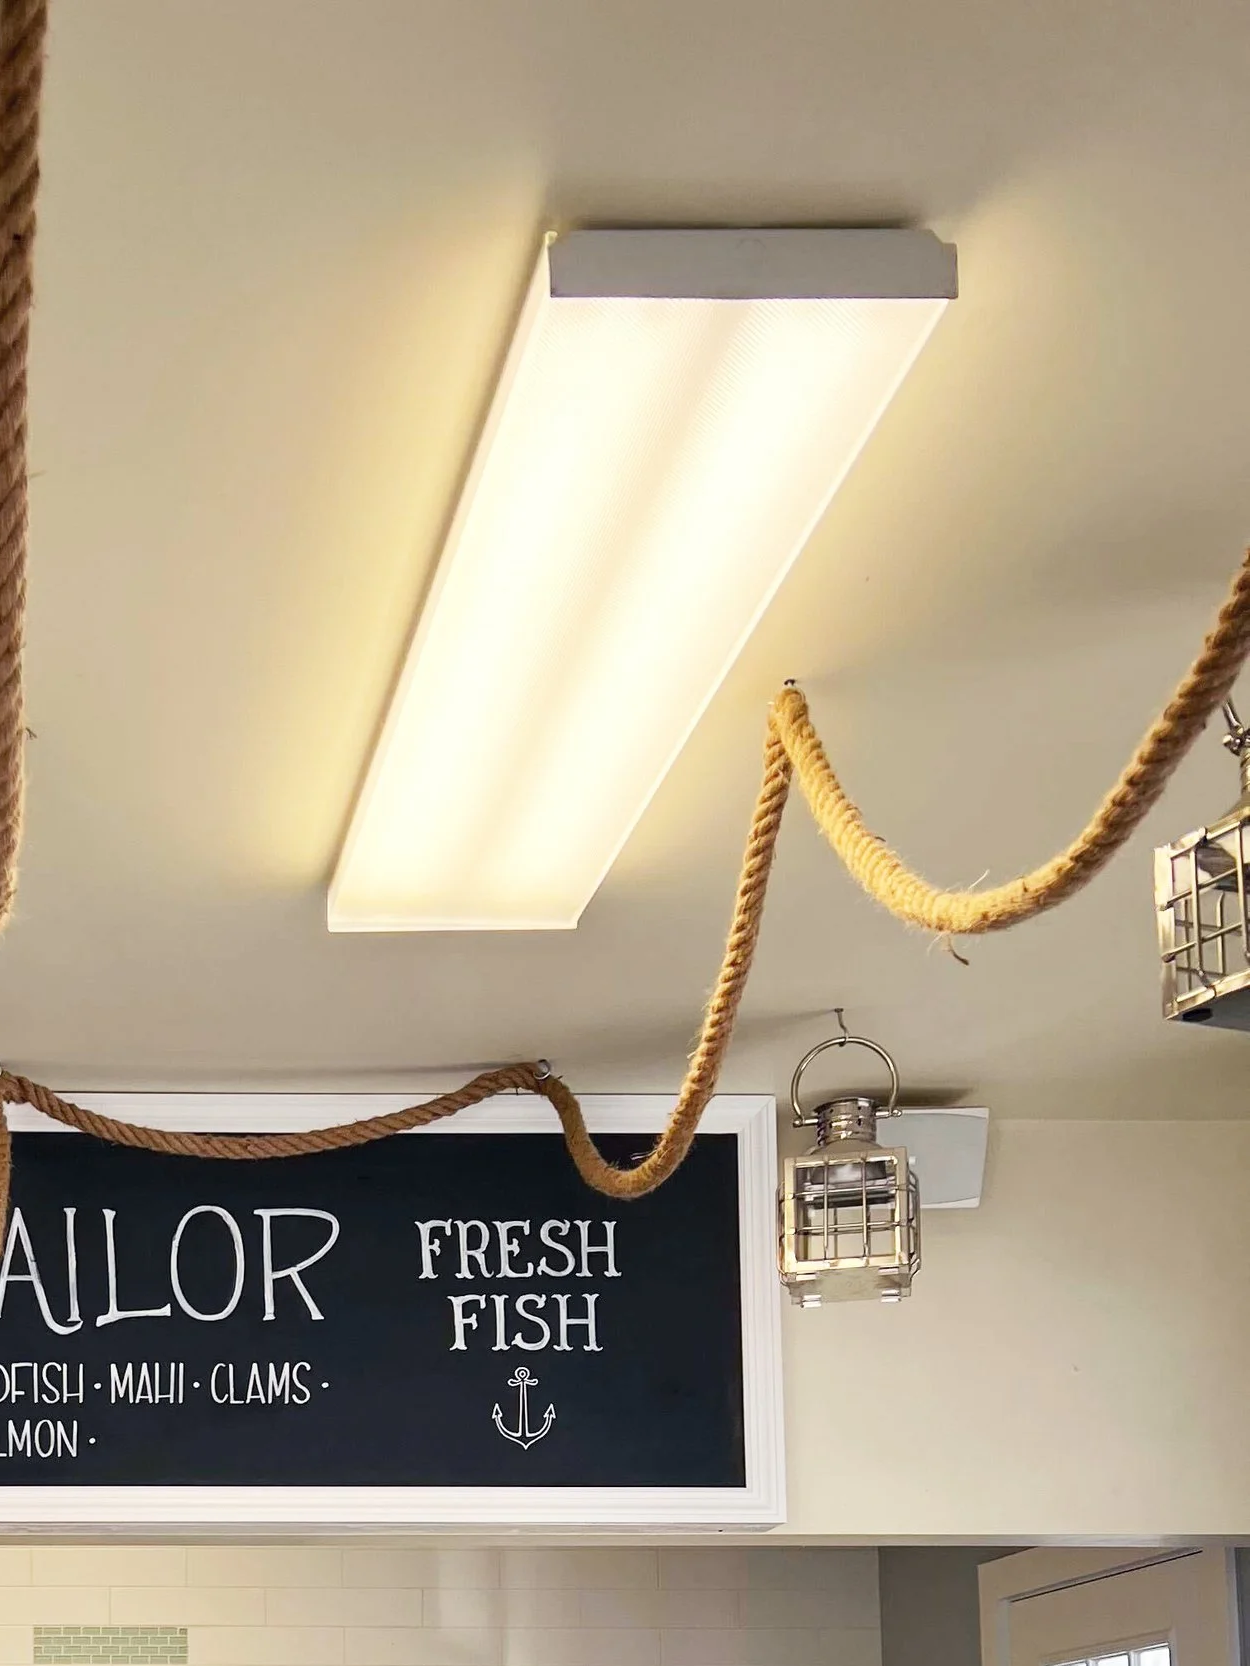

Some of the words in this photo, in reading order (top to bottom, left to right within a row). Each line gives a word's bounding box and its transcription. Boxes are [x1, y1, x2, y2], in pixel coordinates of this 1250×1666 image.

[414, 1218, 622, 1280] FRESH
[446, 1293, 604, 1352] FISH
[110, 1361, 184, 1404] MAHI
[210, 1361, 312, 1405] CLAMS
